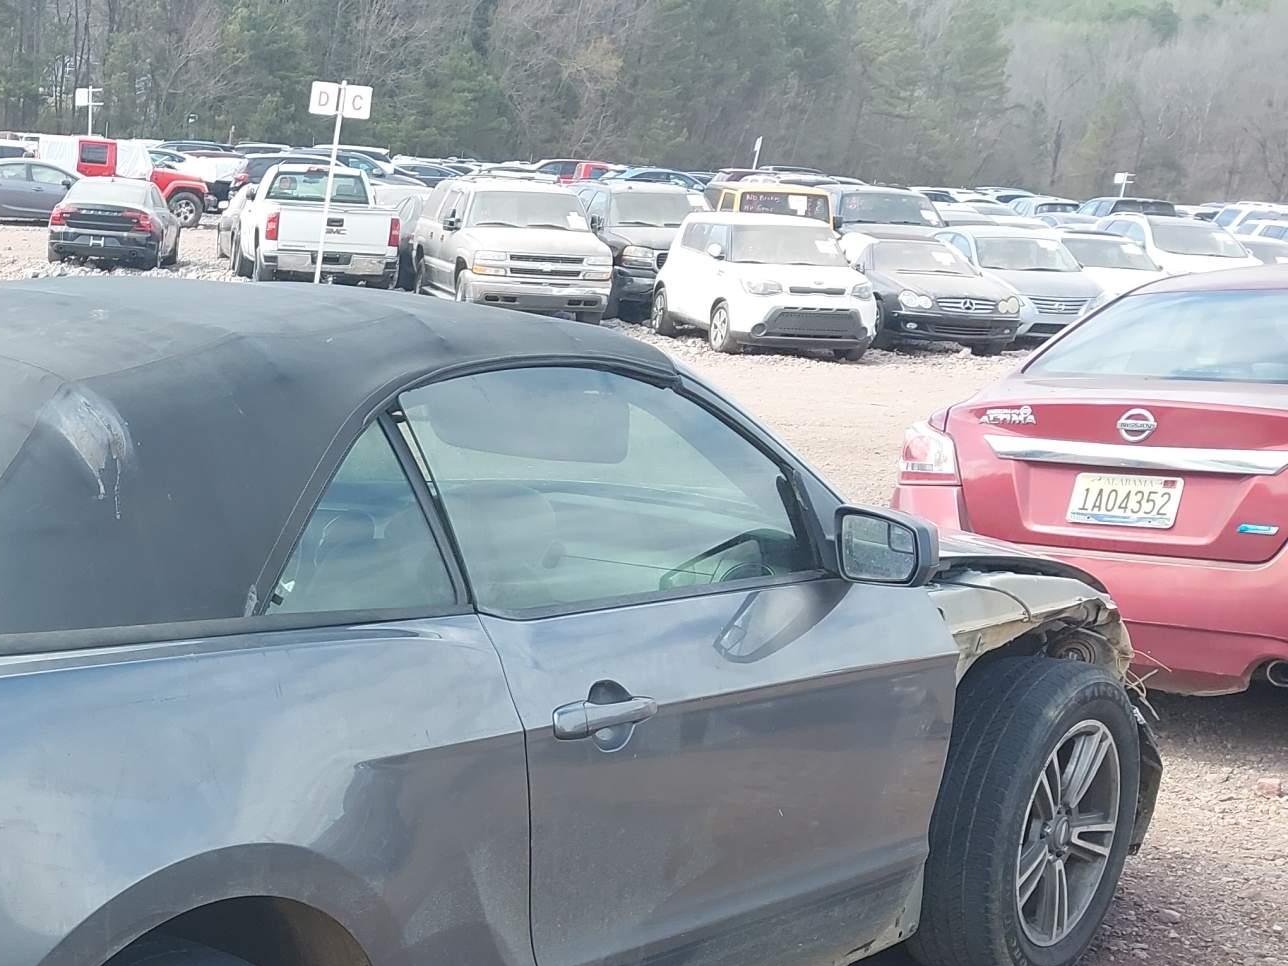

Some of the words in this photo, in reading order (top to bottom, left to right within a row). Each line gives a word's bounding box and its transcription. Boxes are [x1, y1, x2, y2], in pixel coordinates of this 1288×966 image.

[318, 91, 329, 107] D
[352, 94, 364, 111] C
[1078, 488, 1172, 516] 1A04352
